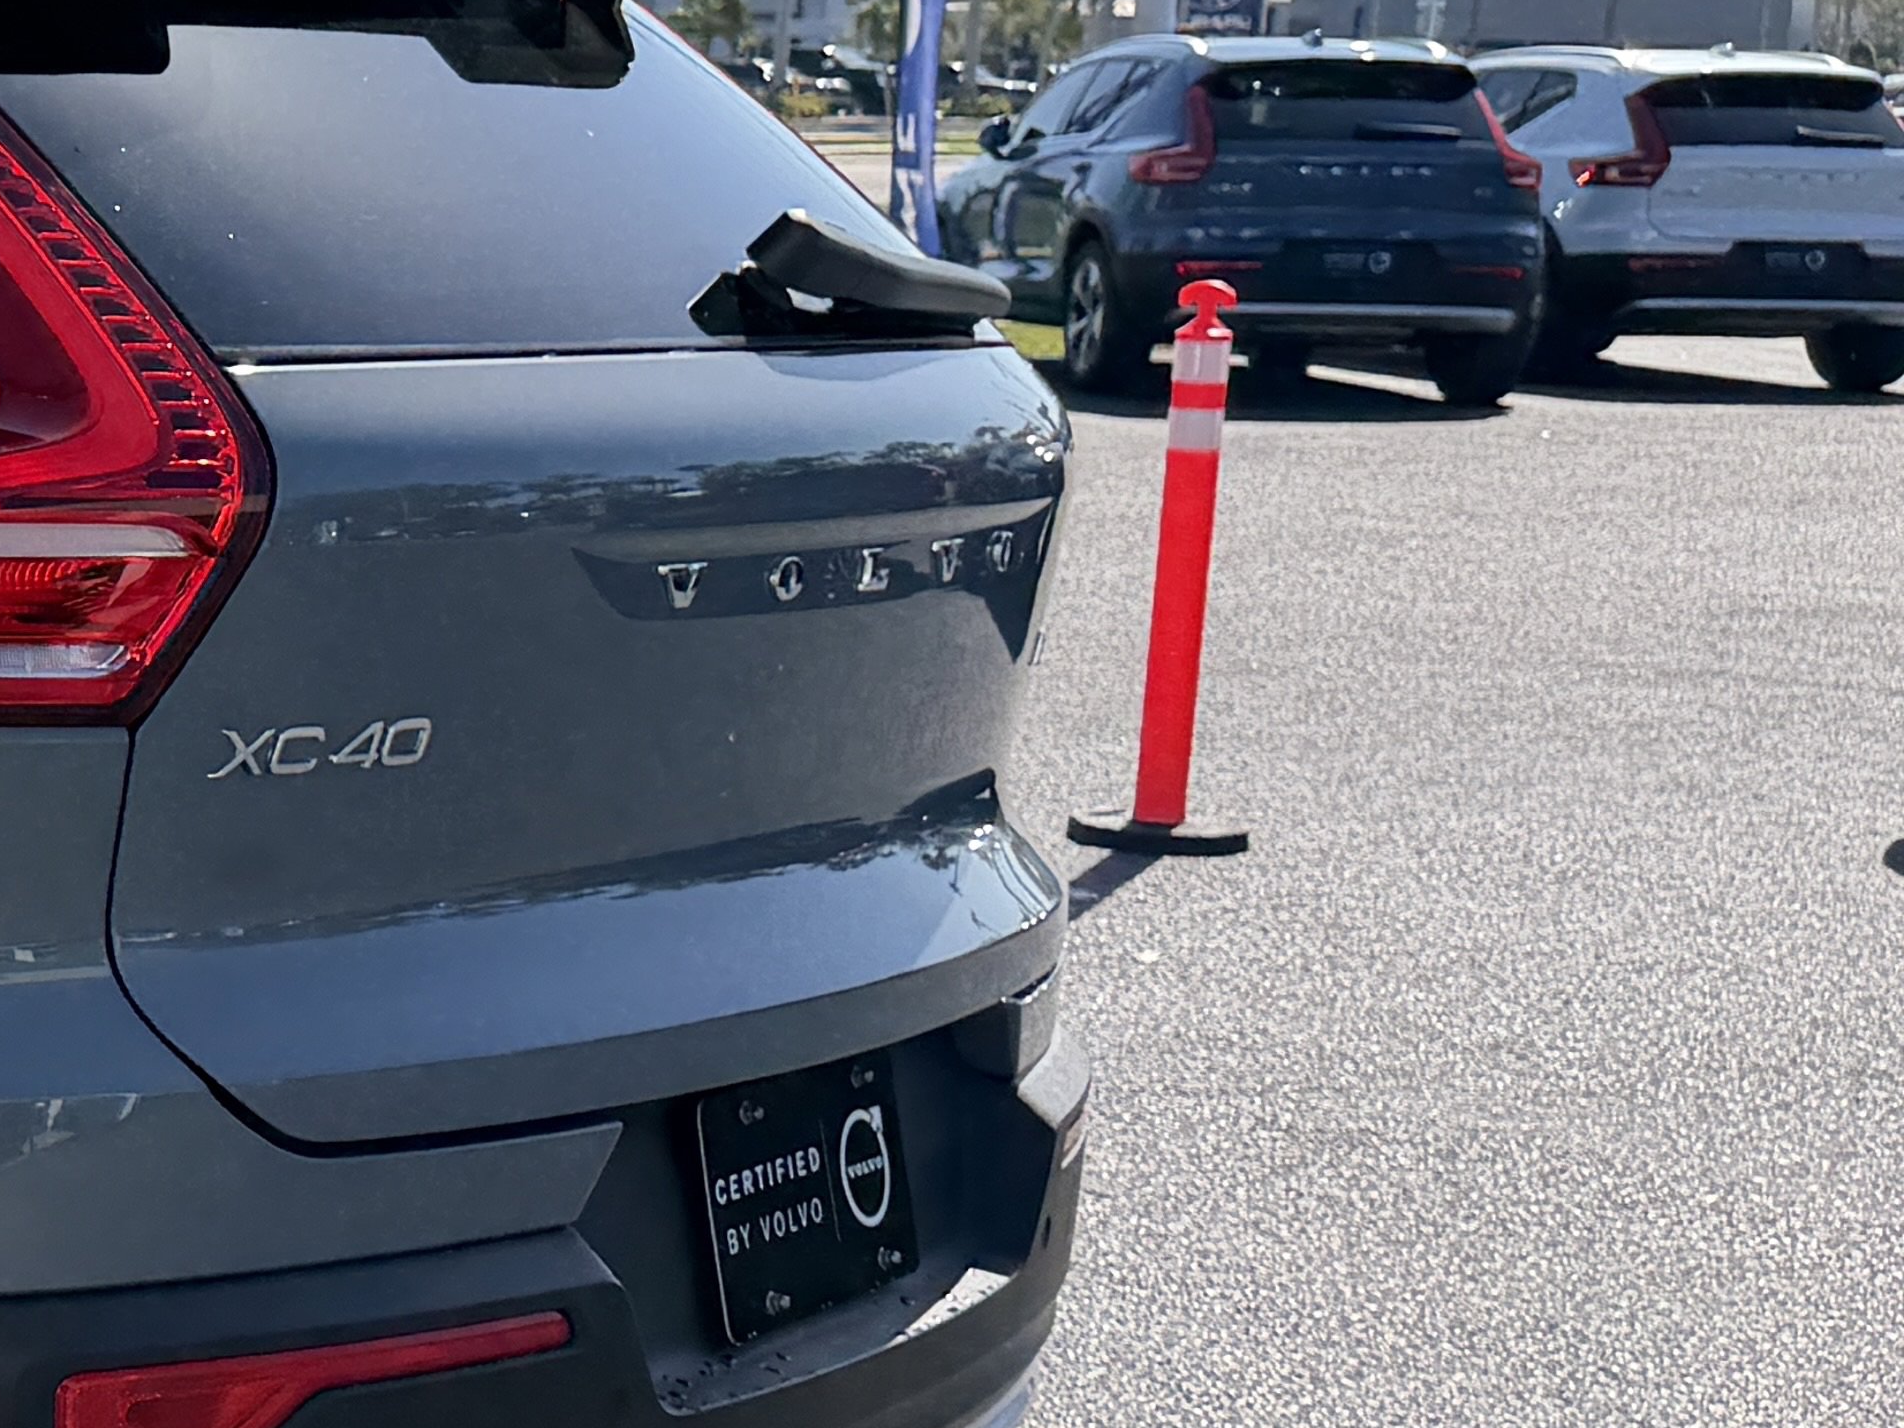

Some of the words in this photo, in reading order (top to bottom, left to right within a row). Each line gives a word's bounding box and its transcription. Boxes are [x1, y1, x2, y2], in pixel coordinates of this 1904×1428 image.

[656, 529, 1015, 610] VOLVO
[206, 716, 432, 780] XC40
[714, 1146, 821, 1206] CERTIFIED
[726, 1222, 751, 1256] BY
[759, 1197, 824, 1243] VOLVO
